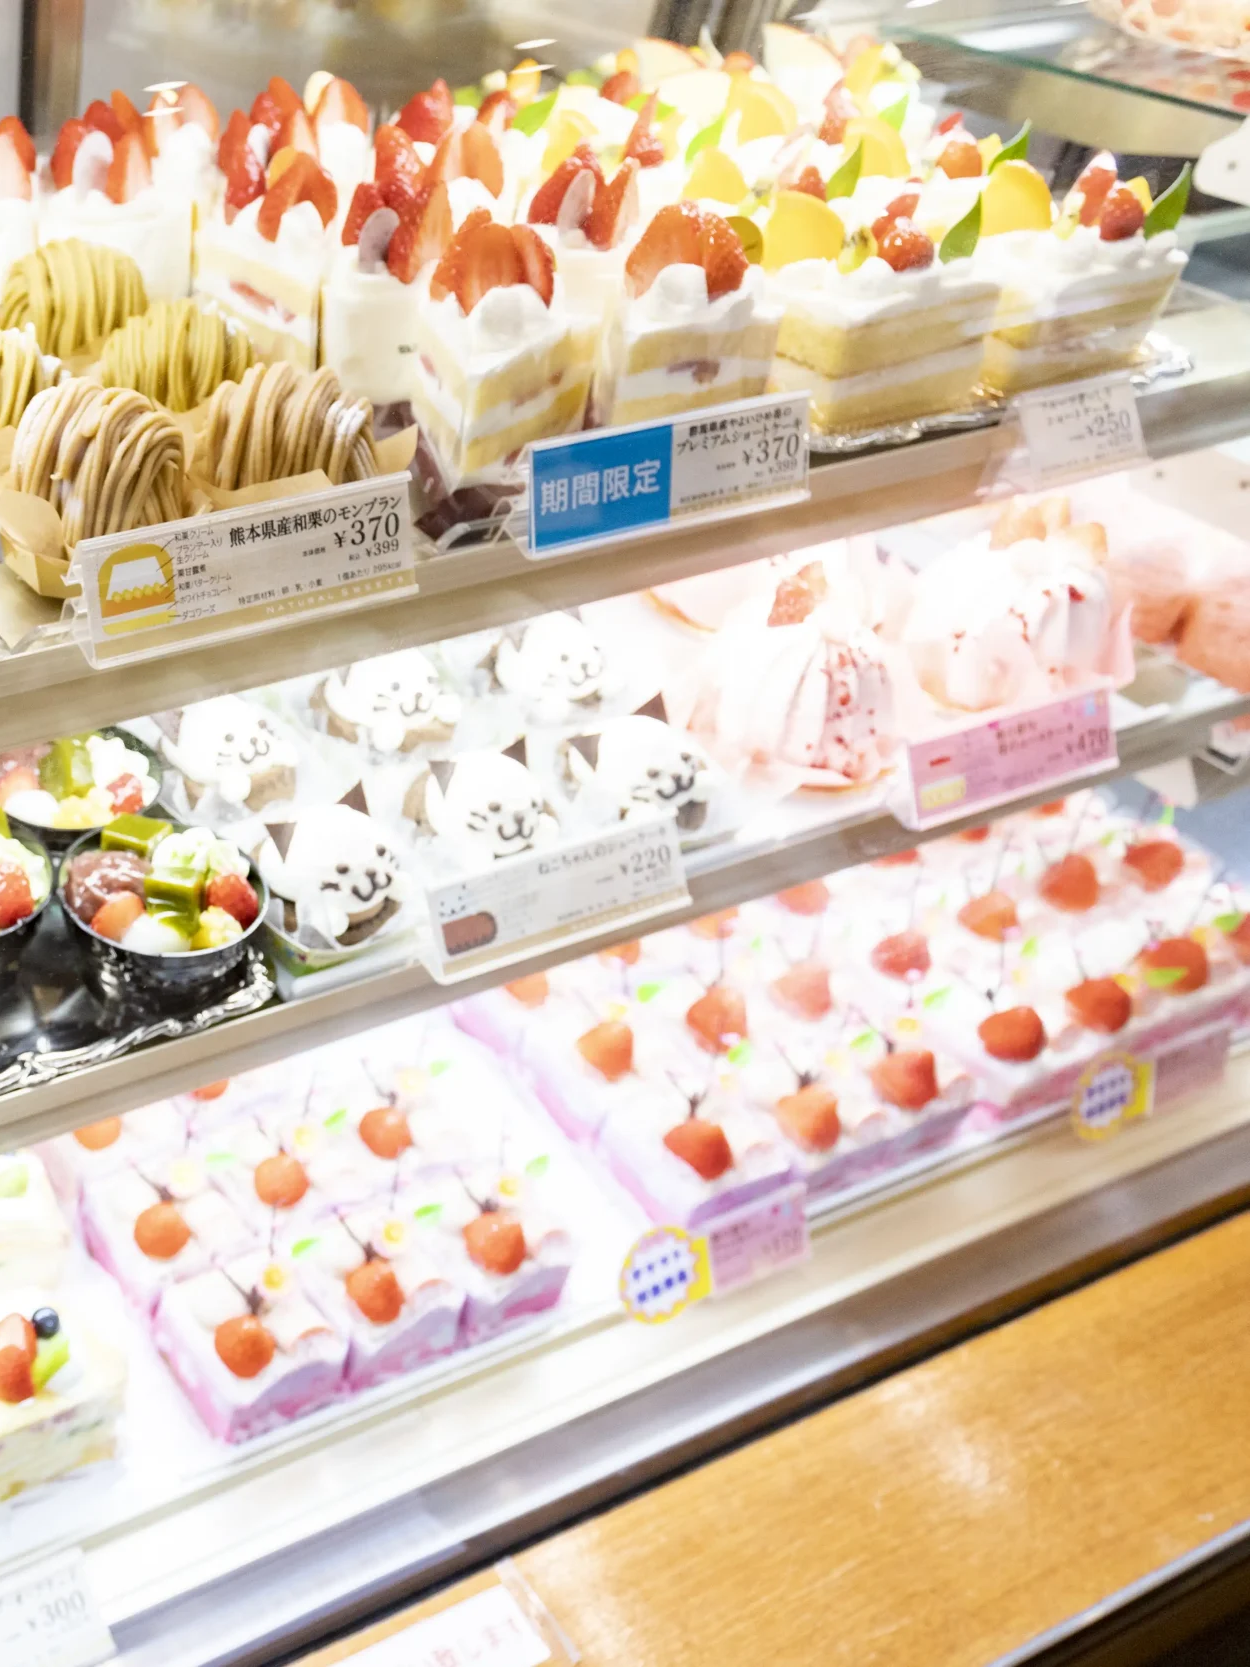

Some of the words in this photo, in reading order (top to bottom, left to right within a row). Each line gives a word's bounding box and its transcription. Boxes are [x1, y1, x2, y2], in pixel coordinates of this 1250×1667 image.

[743, 433, 799, 466] ¥370
[541, 459, 661, 516] 期間限定
[229, 496, 402, 548] 熊本県産和栗のモンブラン
[333, 512, 400, 548] ¥370
[176, 551, 209, 565] 生クリーム
[365, 538, 399, 558] ¥399
[182, 604, 216, 620] ダコワーズ
[266, 593, 334, 614] NATURAL
[619, 844, 671, 876] ¥220
[26, 1590, 86, 1630] ¥300
